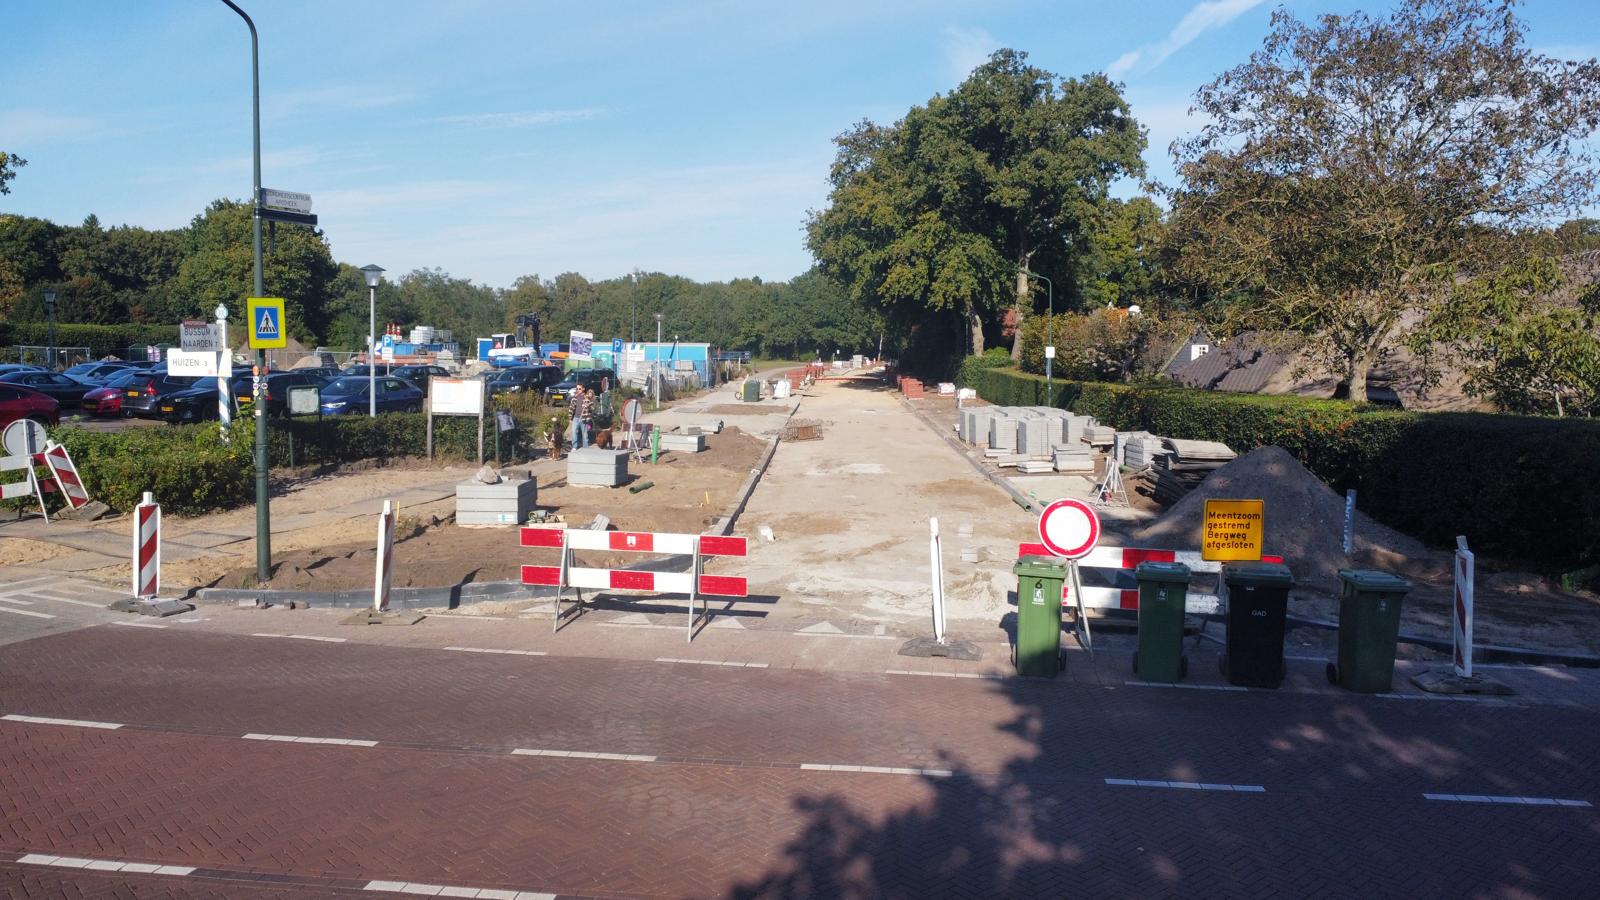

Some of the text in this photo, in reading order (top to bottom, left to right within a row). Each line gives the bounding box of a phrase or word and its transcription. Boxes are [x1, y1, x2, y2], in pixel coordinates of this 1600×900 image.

[184, 327, 210, 336] BUSSUM
[183, 340, 213, 348] NAARDEN
[172, 358, 200, 367] HUIZEN
[1208, 511, 1260, 520] Meentzoom
[1207, 522, 1251, 531] gestremd
[1207, 530, 1247, 541] Bergweg
[1206, 541, 1255, 550] afgesloten
[1035, 579, 1043, 589] 6
